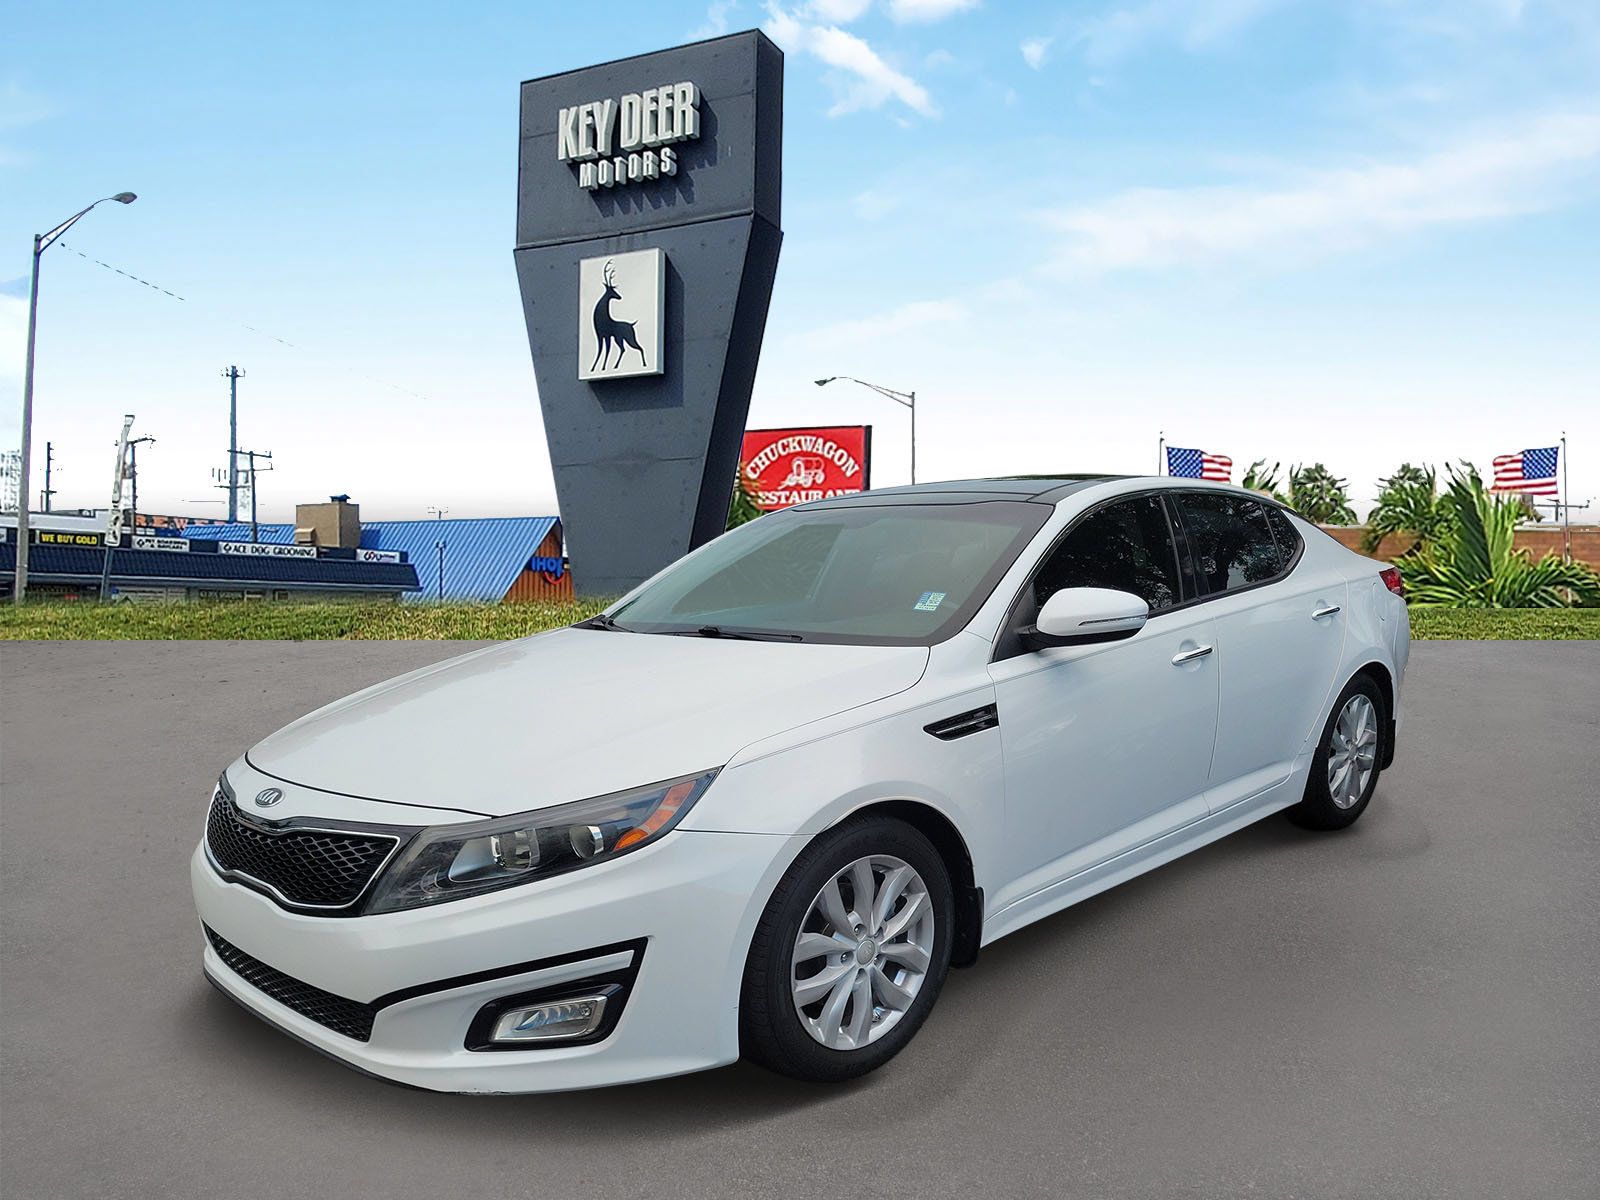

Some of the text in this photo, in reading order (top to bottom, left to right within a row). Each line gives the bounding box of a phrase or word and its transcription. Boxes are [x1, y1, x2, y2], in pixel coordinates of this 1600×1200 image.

[558, 81, 700, 161] KEY DEER
[579, 147, 677, 191] MOTORS
[745, 435, 860, 479] CHUCKWAGON
[41, 533, 97, 545] WE BUY GOLD
[233, 544, 315, 557] ACE DOG GROOMING
